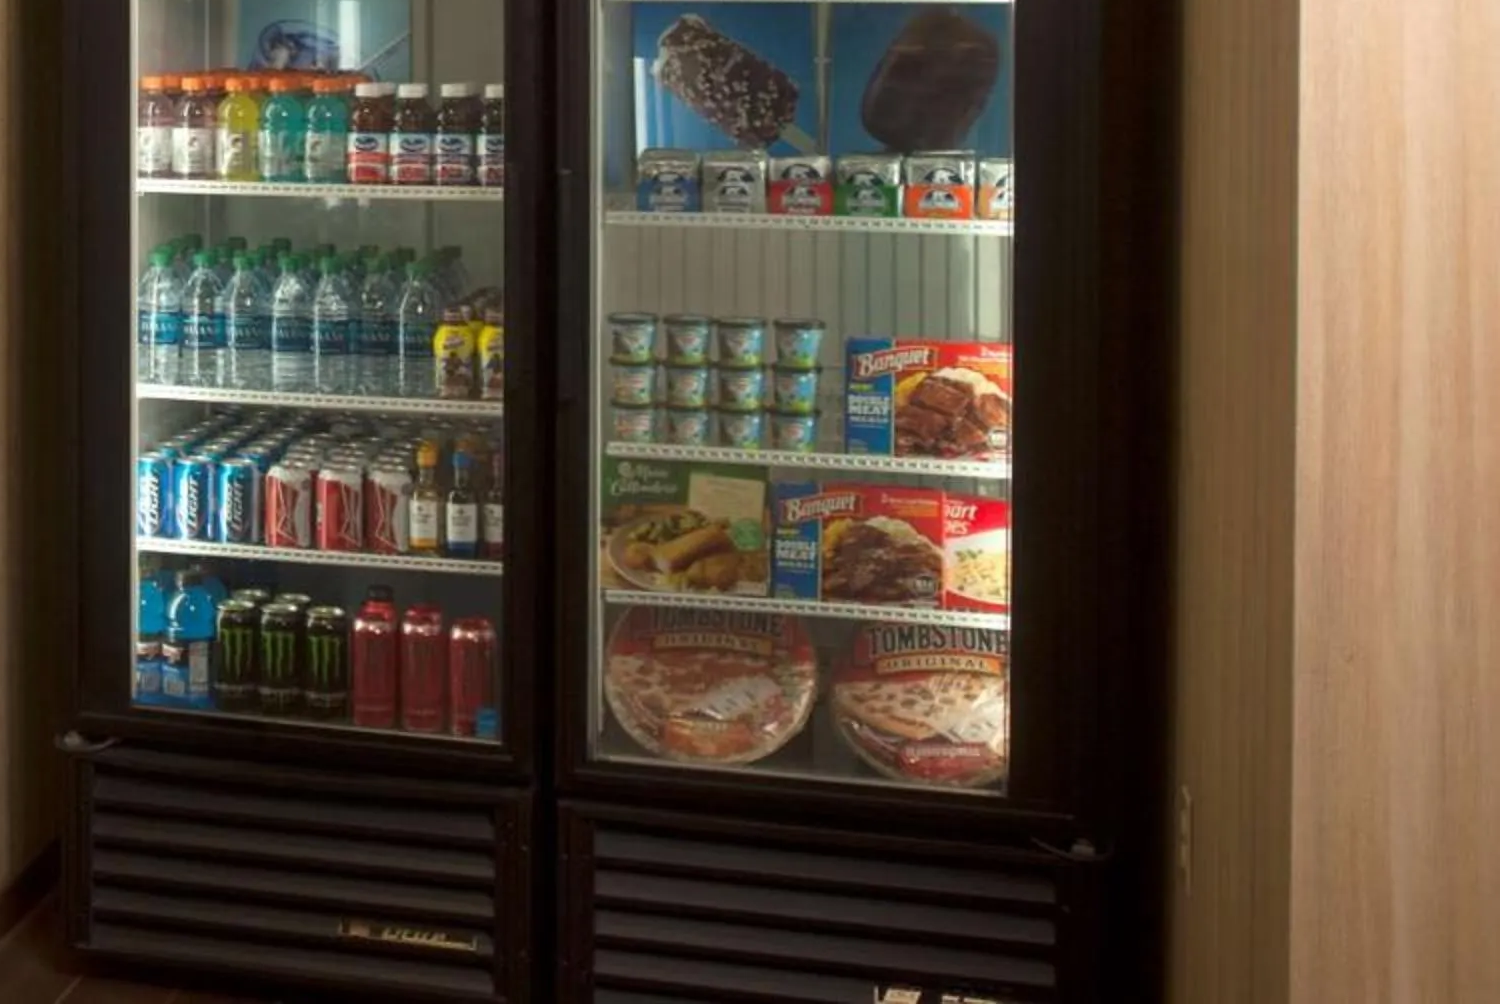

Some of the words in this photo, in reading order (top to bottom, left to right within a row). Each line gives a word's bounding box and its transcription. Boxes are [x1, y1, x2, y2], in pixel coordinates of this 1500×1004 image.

[857, 347, 929, 376] Banquet
[231, 480, 244, 533] LIGHT
[785, 494, 856, 521] Banquet
[945, 505, 978, 520] art
[869, 624, 1008, 656] TOMBSTONE
[886, 656, 987, 672] ORIGINAL
